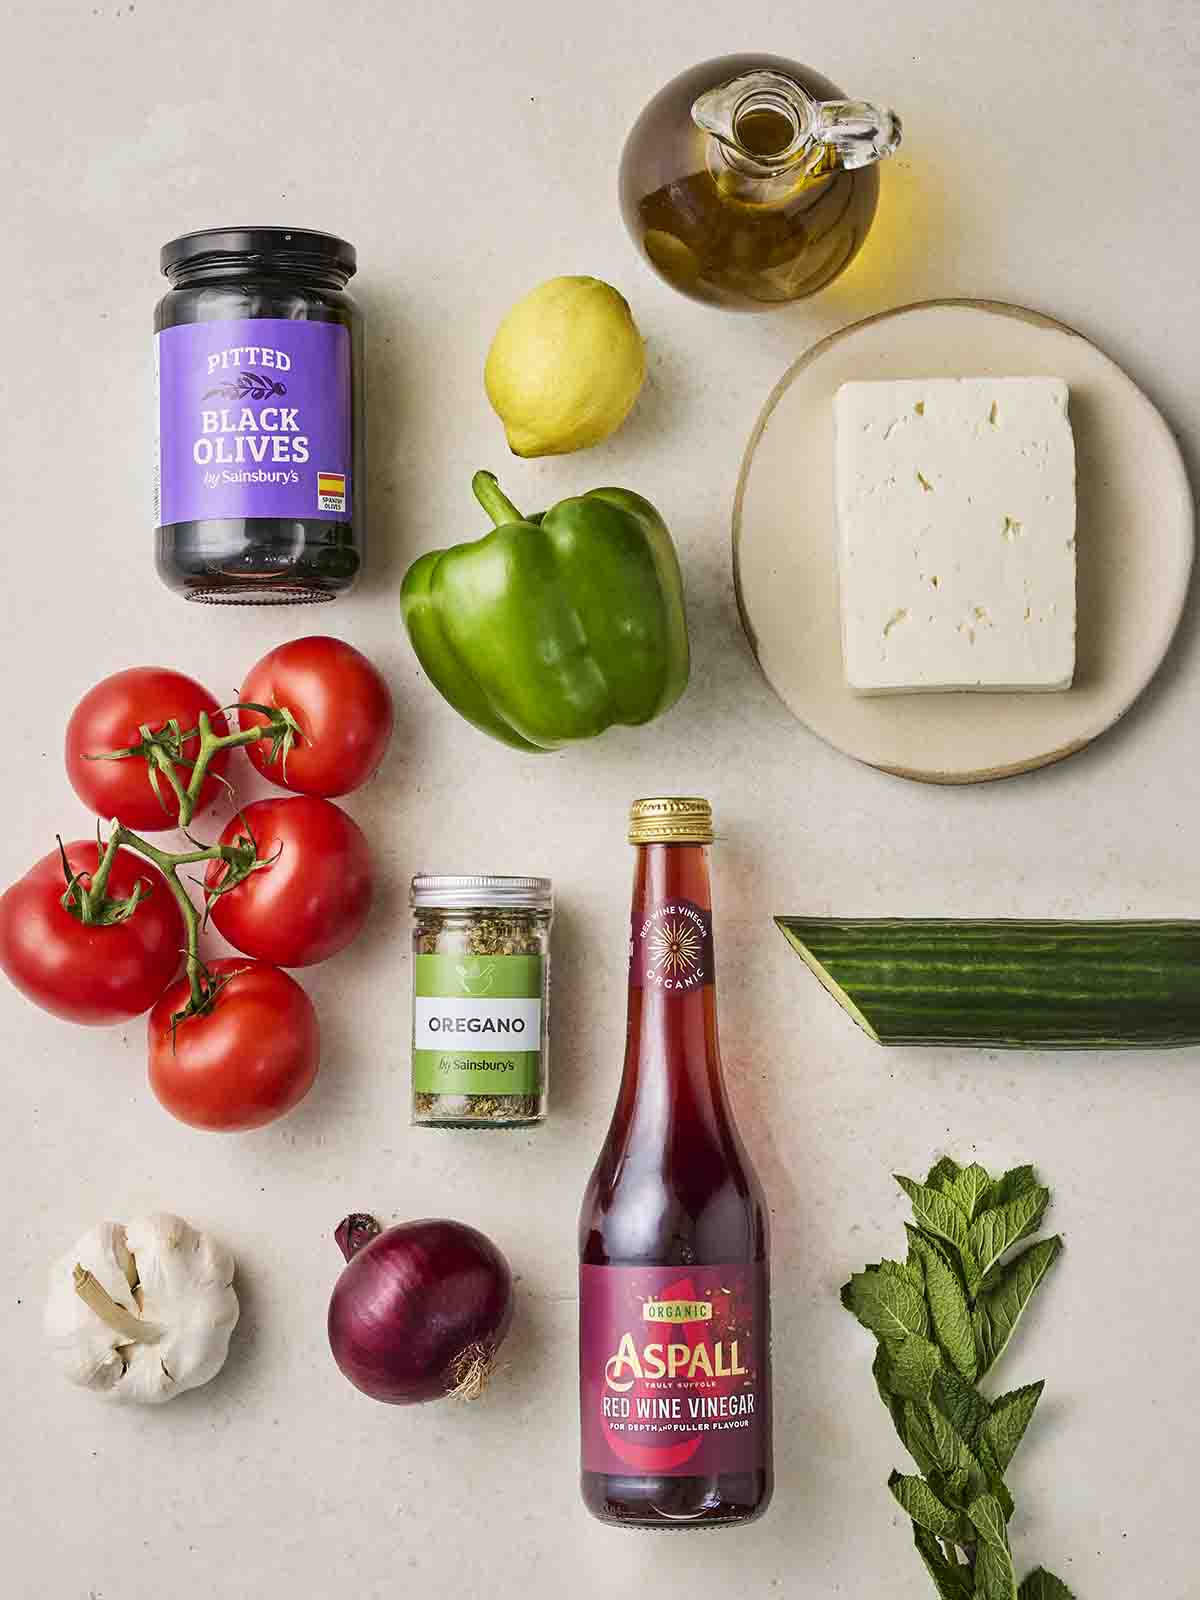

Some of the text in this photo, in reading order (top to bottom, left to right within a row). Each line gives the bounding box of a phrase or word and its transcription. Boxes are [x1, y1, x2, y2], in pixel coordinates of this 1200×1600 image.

[207, 347, 291, 374] PITTED
[202, 407, 299, 433] BLACK
[193, 436, 309, 464] OLIVES
[204, 469, 299, 488] by Sainsbury's
[640, 906, 707, 938] RED WINE VINEGAR
[646, 968, 704, 990] ORGANIC
[428, 1017, 525, 1033] OREGANO
[438, 1057, 515, 1074] by Sainsbury's
[648, 1304, 708, 1319] ORGANIC
[604, 1332, 746, 1391] ASPALL
[645, 1381, 717, 1389] TRULY SUFFOLK
[603, 1393, 755, 1419] RED WINE VINEGAR
[609, 1423, 625, 1432] FOR
[628, 1424, 657, 1432] DEPTH
[673, 1423, 710, 1432] FULLER
[712, 1420, 749, 1430] FLAVOUR
